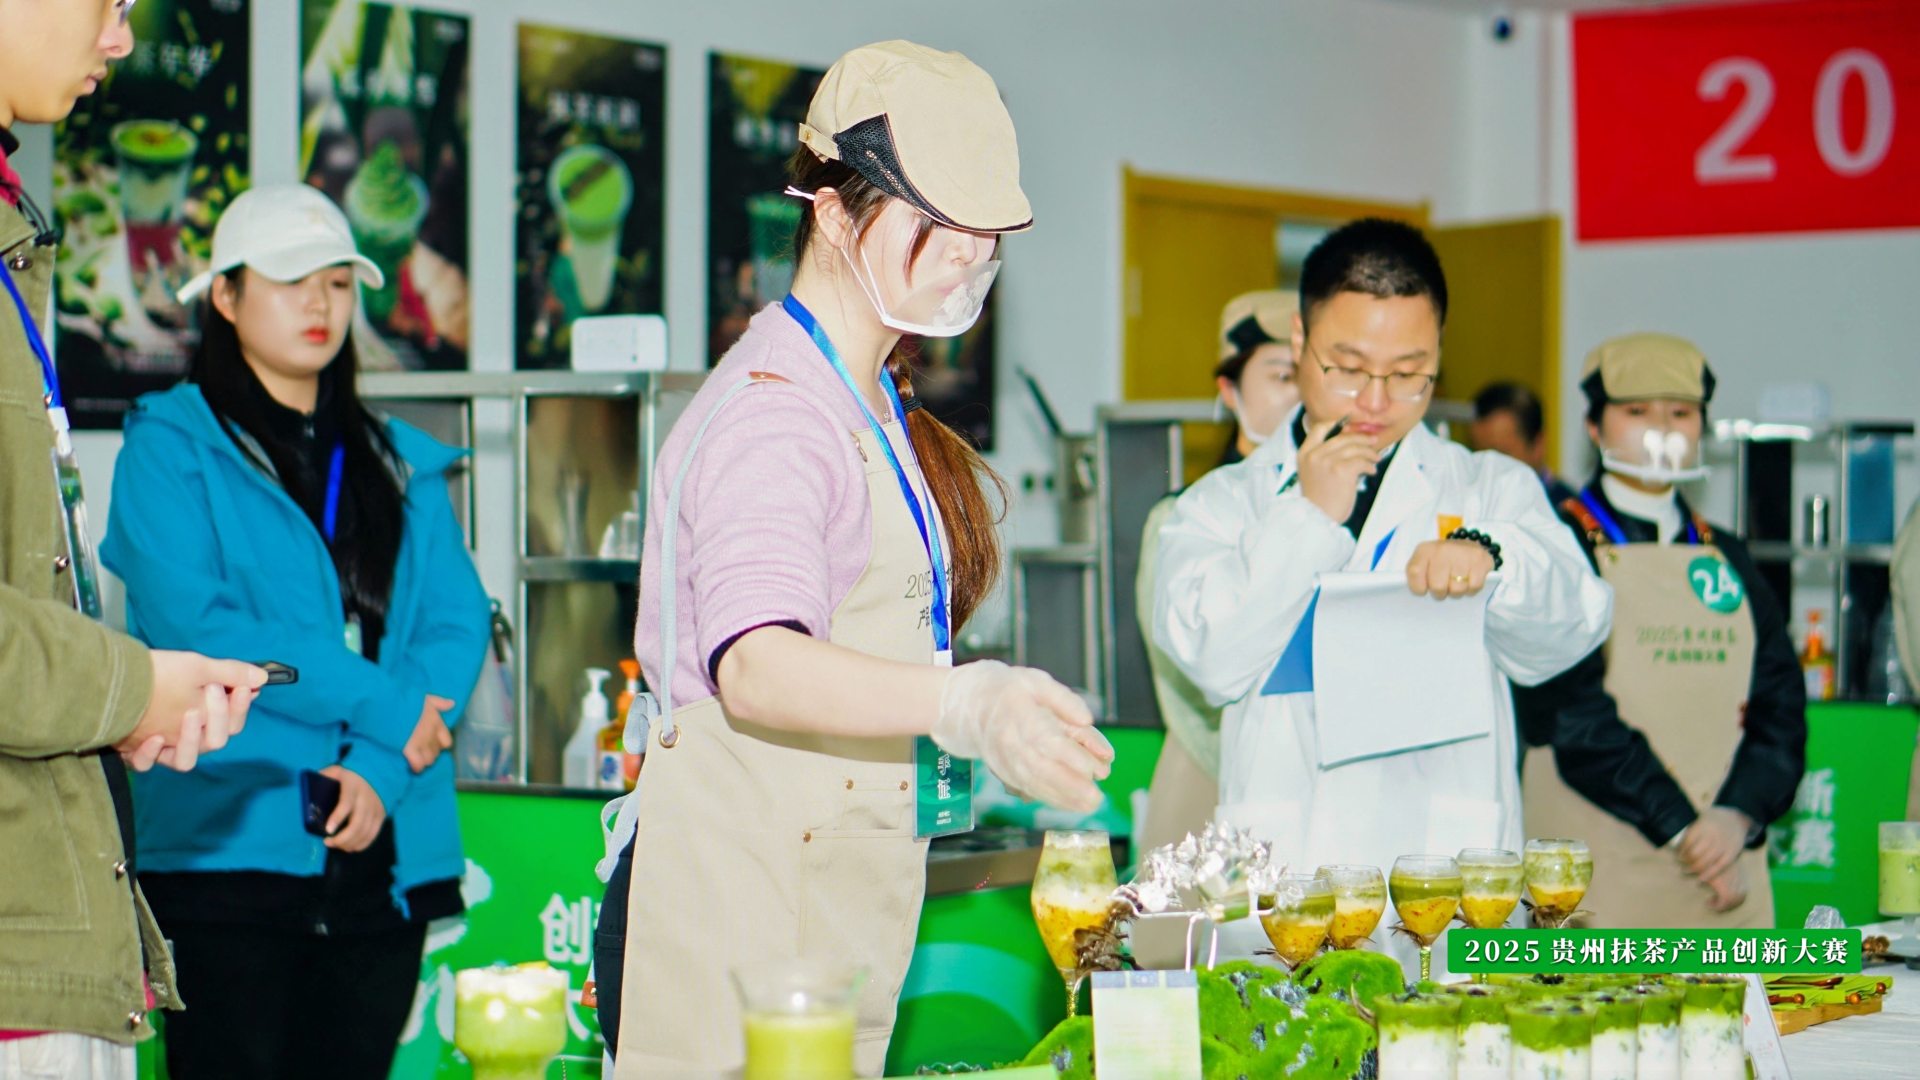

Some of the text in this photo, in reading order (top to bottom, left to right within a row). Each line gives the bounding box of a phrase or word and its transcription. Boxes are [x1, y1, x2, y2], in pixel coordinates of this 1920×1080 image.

[1694, 47, 1896, 186] 20
[1692, 563, 1739, 604] 24
[539, 893, 602, 965] 创
